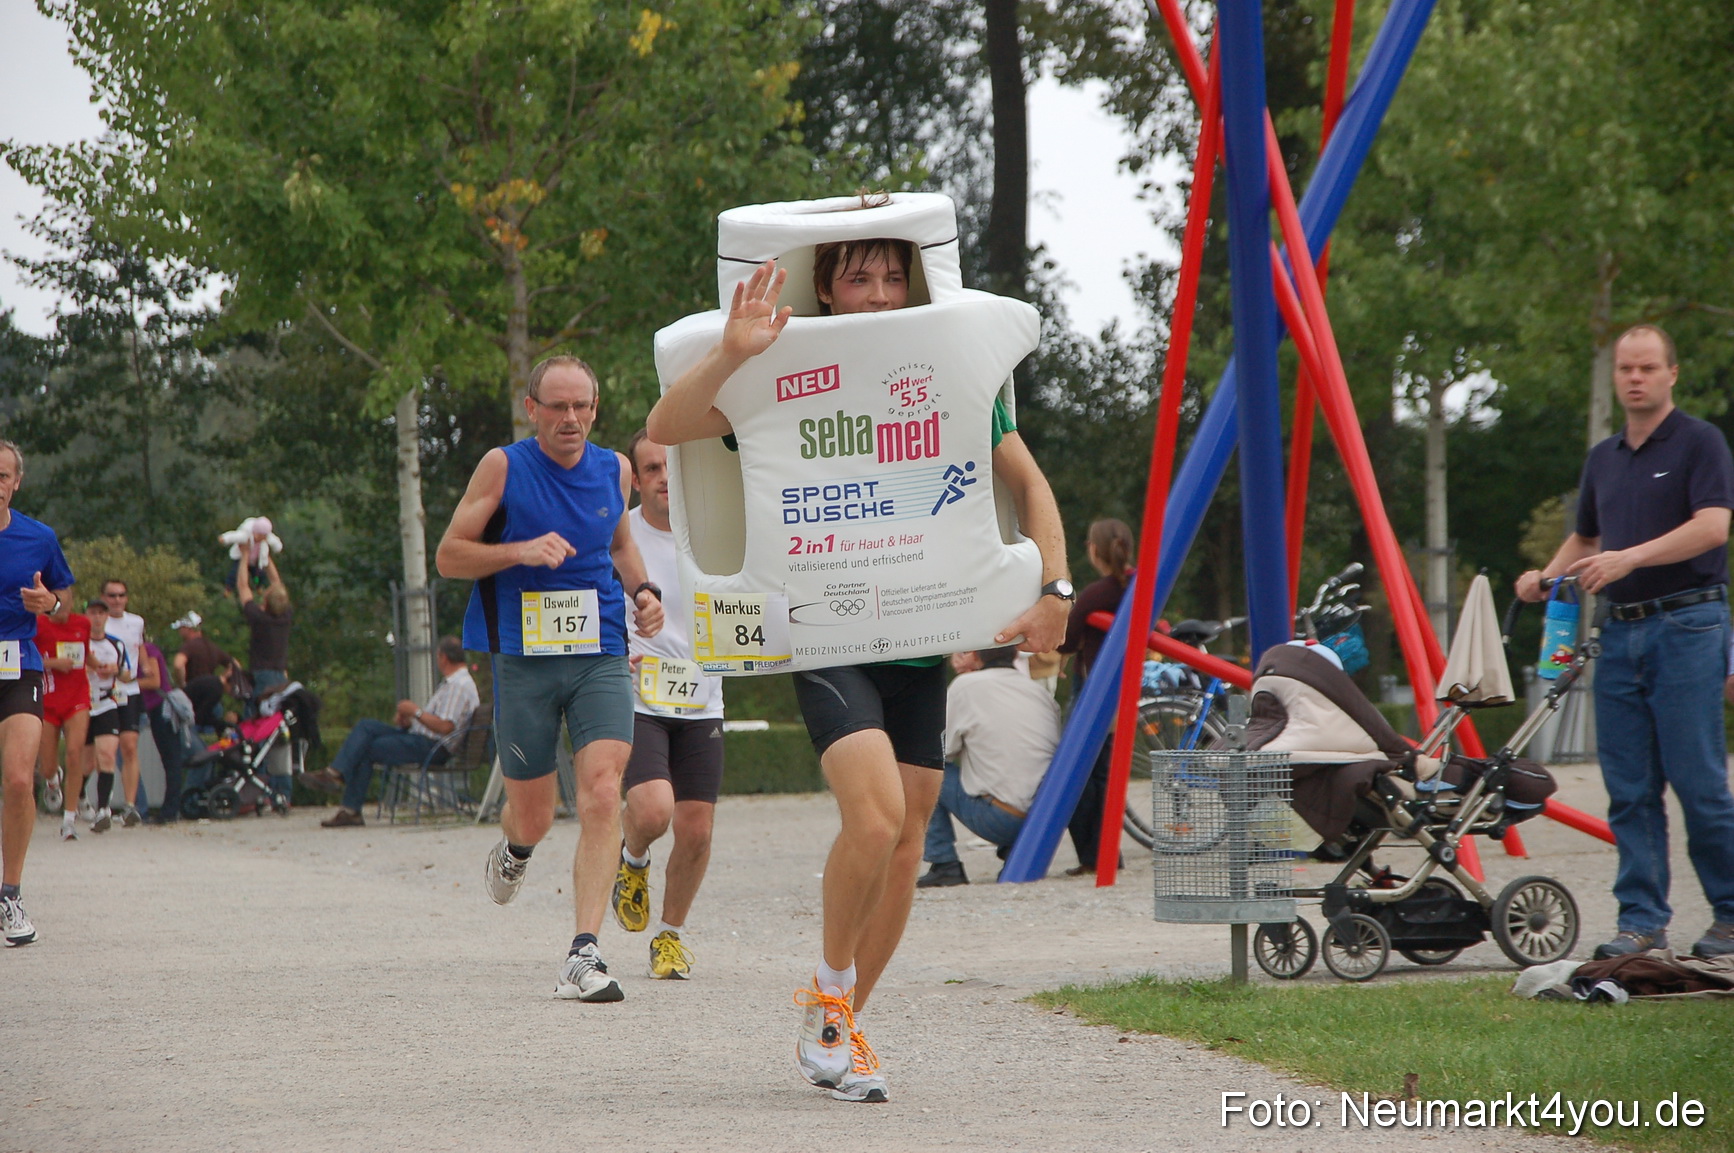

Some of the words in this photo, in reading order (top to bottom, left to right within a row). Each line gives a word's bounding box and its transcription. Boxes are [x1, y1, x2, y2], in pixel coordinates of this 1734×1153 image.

[777, 366, 839, 400] NEU
[881, 362, 935, 385] klinisch
[890, 376, 910, 396] pH
[901, 385, 928, 408] 5,5
[888, 393, 942, 418] geprüft
[782, 481, 879, 505] SPORT
[783, 500, 895, 525] DUSCHE
[839, 540, 856, 553] für
[858, 538, 885, 551] Haut
[887, 536, 896, 547] &
[899, 533, 925, 547] Haar
[788, 558, 848, 573] vitalisierend
[851, 556, 869, 568] und
[872, 550, 925, 567] erfrischend
[823, 588, 870, 597] Deutschland
[880, 589, 910, 597] Offizieller
[910, 583, 937, 594] Lieferant
[937, 581, 948, 590] der
[881, 596, 913, 608] deutschen
[913, 586, 978, 604] Olympiamannschaften
[544, 596, 579, 609] Oswald
[714, 599, 761, 615] Markus
[882, 606, 914, 617] Vancouver
[915, 603, 931, 613] 2010
[936, 599, 959, 610] London
[959, 595, 975, 606] 2012
[526, 616, 532, 626] B
[553, 615, 588, 633] 157
[735, 624, 766, 647] 84
[795, 643, 867, 657] MEDIZINISCHE
[895, 630, 962, 649] HAUTPFLEGE
[661, 662, 687, 674] Peter
[667, 680, 699, 697] 747
